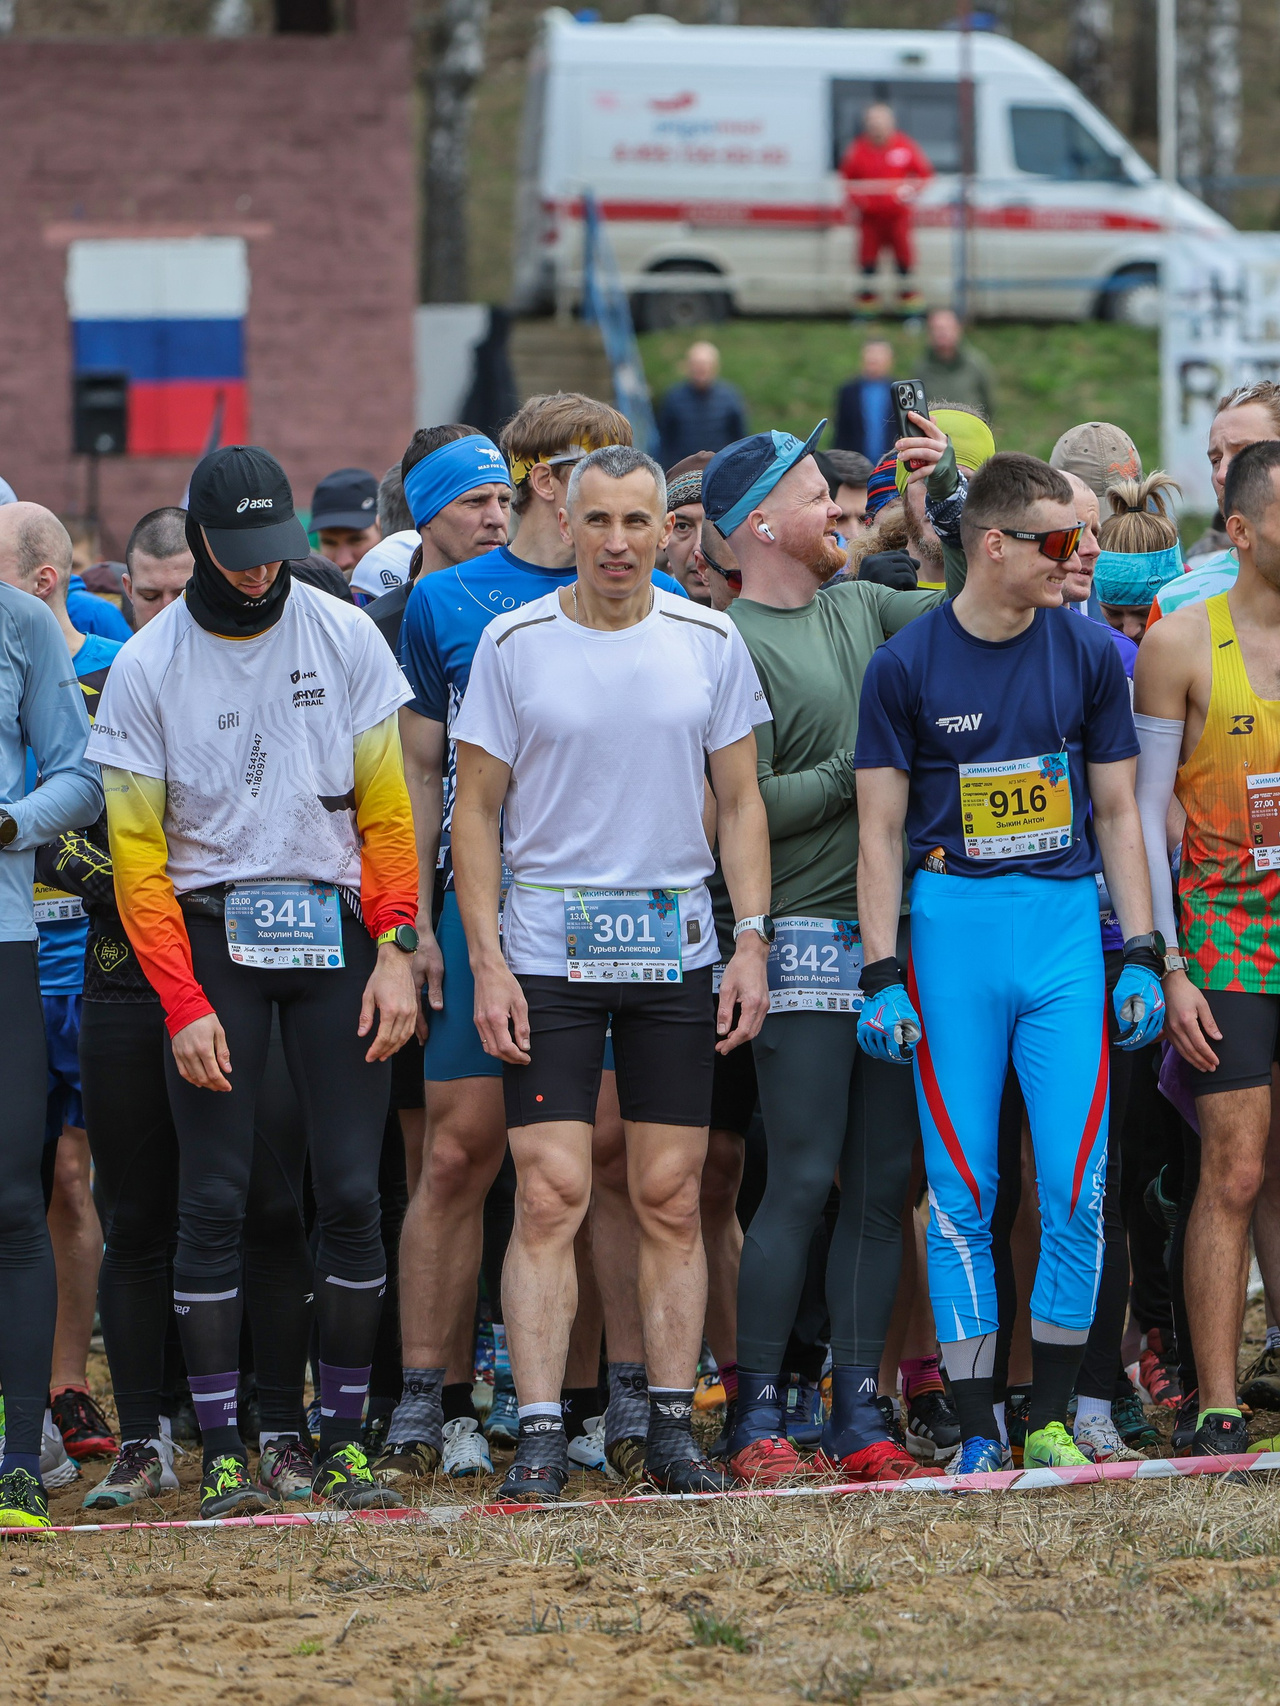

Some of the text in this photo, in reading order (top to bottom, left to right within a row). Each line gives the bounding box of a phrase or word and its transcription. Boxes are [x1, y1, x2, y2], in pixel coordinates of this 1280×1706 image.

[249, 498, 273, 509] asics
[935, 712, 983, 734] RAV
[967, 762, 1031, 774] ХИМКИНСКИЙ ЛЕС
[989, 784, 1047, 818] 916
[1254, 800, 1274, 808] 27,00
[996, 816, 1045, 829] Зыкин Антон
[580, 890, 625, 898] МКИНСКИЙ
[230, 897, 251, 906] 13,00
[254, 899, 316, 928] 341
[569, 912, 590, 920] 13,00
[594, 914, 656, 943] 301
[257, 930, 314, 940] Хахулин Влад
[588, 945, 661, 954] Гурьев Александр
[780, 943, 840, 973] 342
[780, 974, 840, 984] Павлов Андрей
